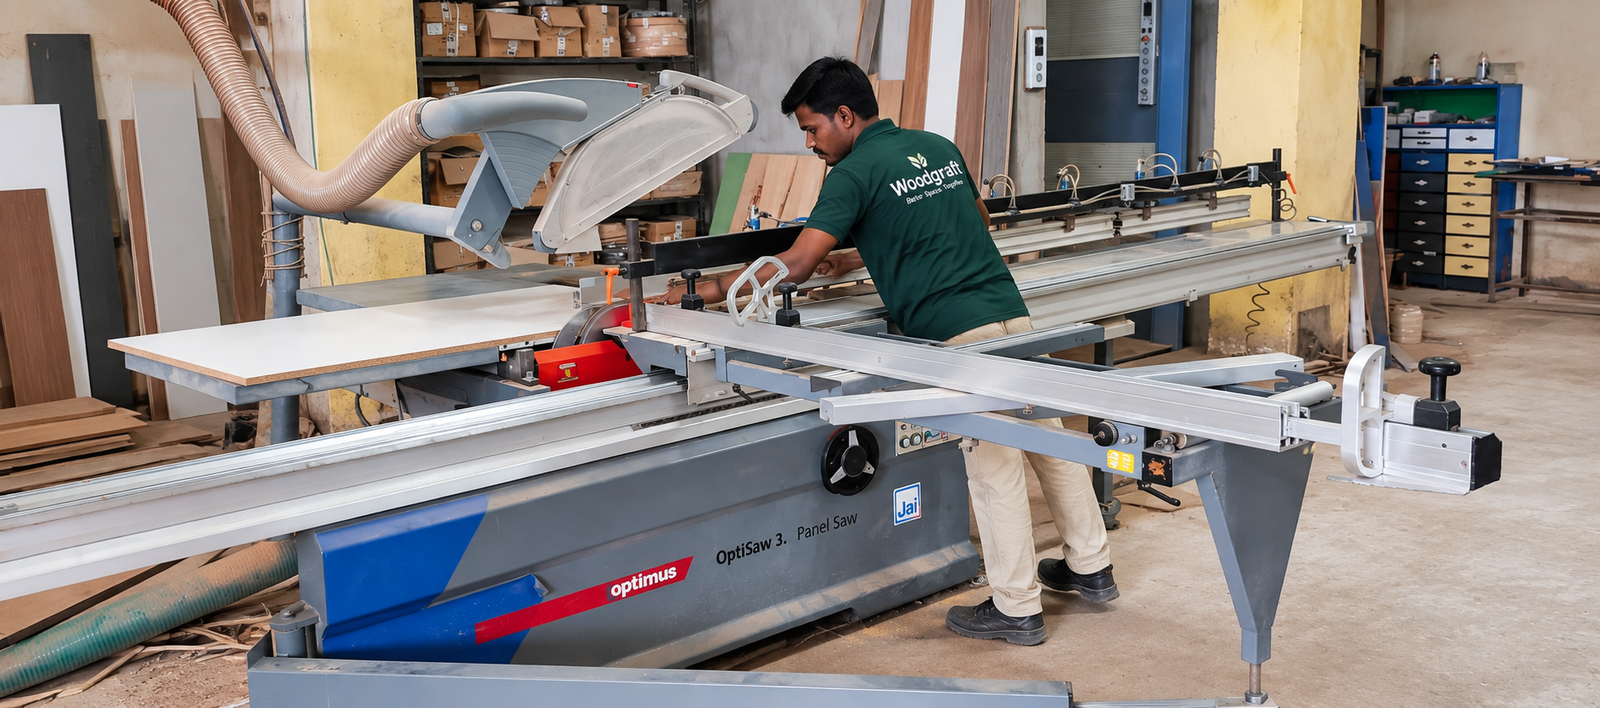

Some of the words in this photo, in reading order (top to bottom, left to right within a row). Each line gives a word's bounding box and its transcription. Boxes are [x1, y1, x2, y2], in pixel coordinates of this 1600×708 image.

[889, 160, 963, 196] Woodgraft
[897, 497, 918, 518] Jai
[716, 534, 772, 566] OptiSaw
[775, 532, 787, 547] 3.
[797, 518, 830, 541] Panel
[833, 512, 858, 530] Saw
[610, 566, 677, 598] optimus
